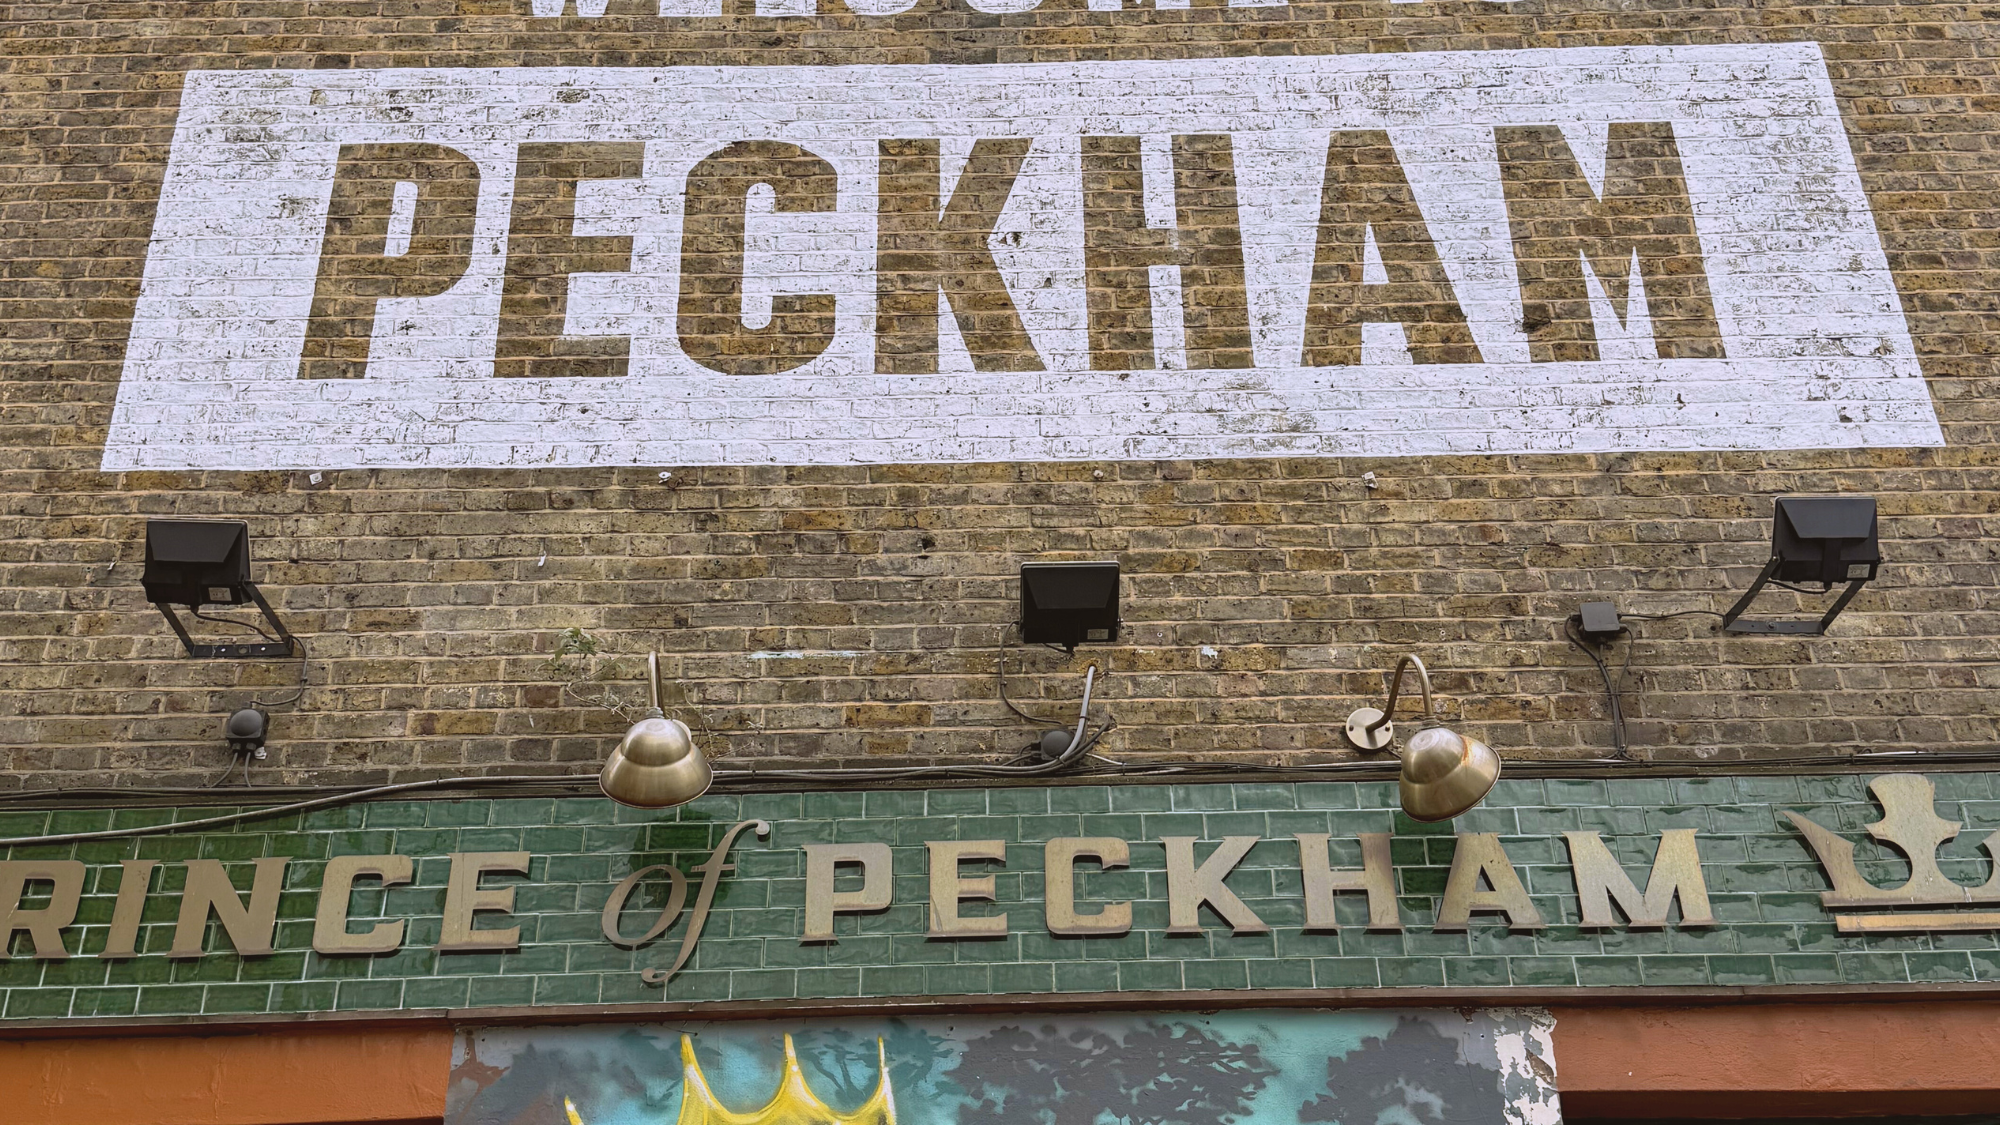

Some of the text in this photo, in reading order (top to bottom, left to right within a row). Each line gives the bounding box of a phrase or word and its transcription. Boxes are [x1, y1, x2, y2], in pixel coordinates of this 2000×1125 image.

[298, 122, 1726, 379] PECKHAM
[601, 818, 771, 984] of
[803, 828, 1716, 943] PECKHAM
